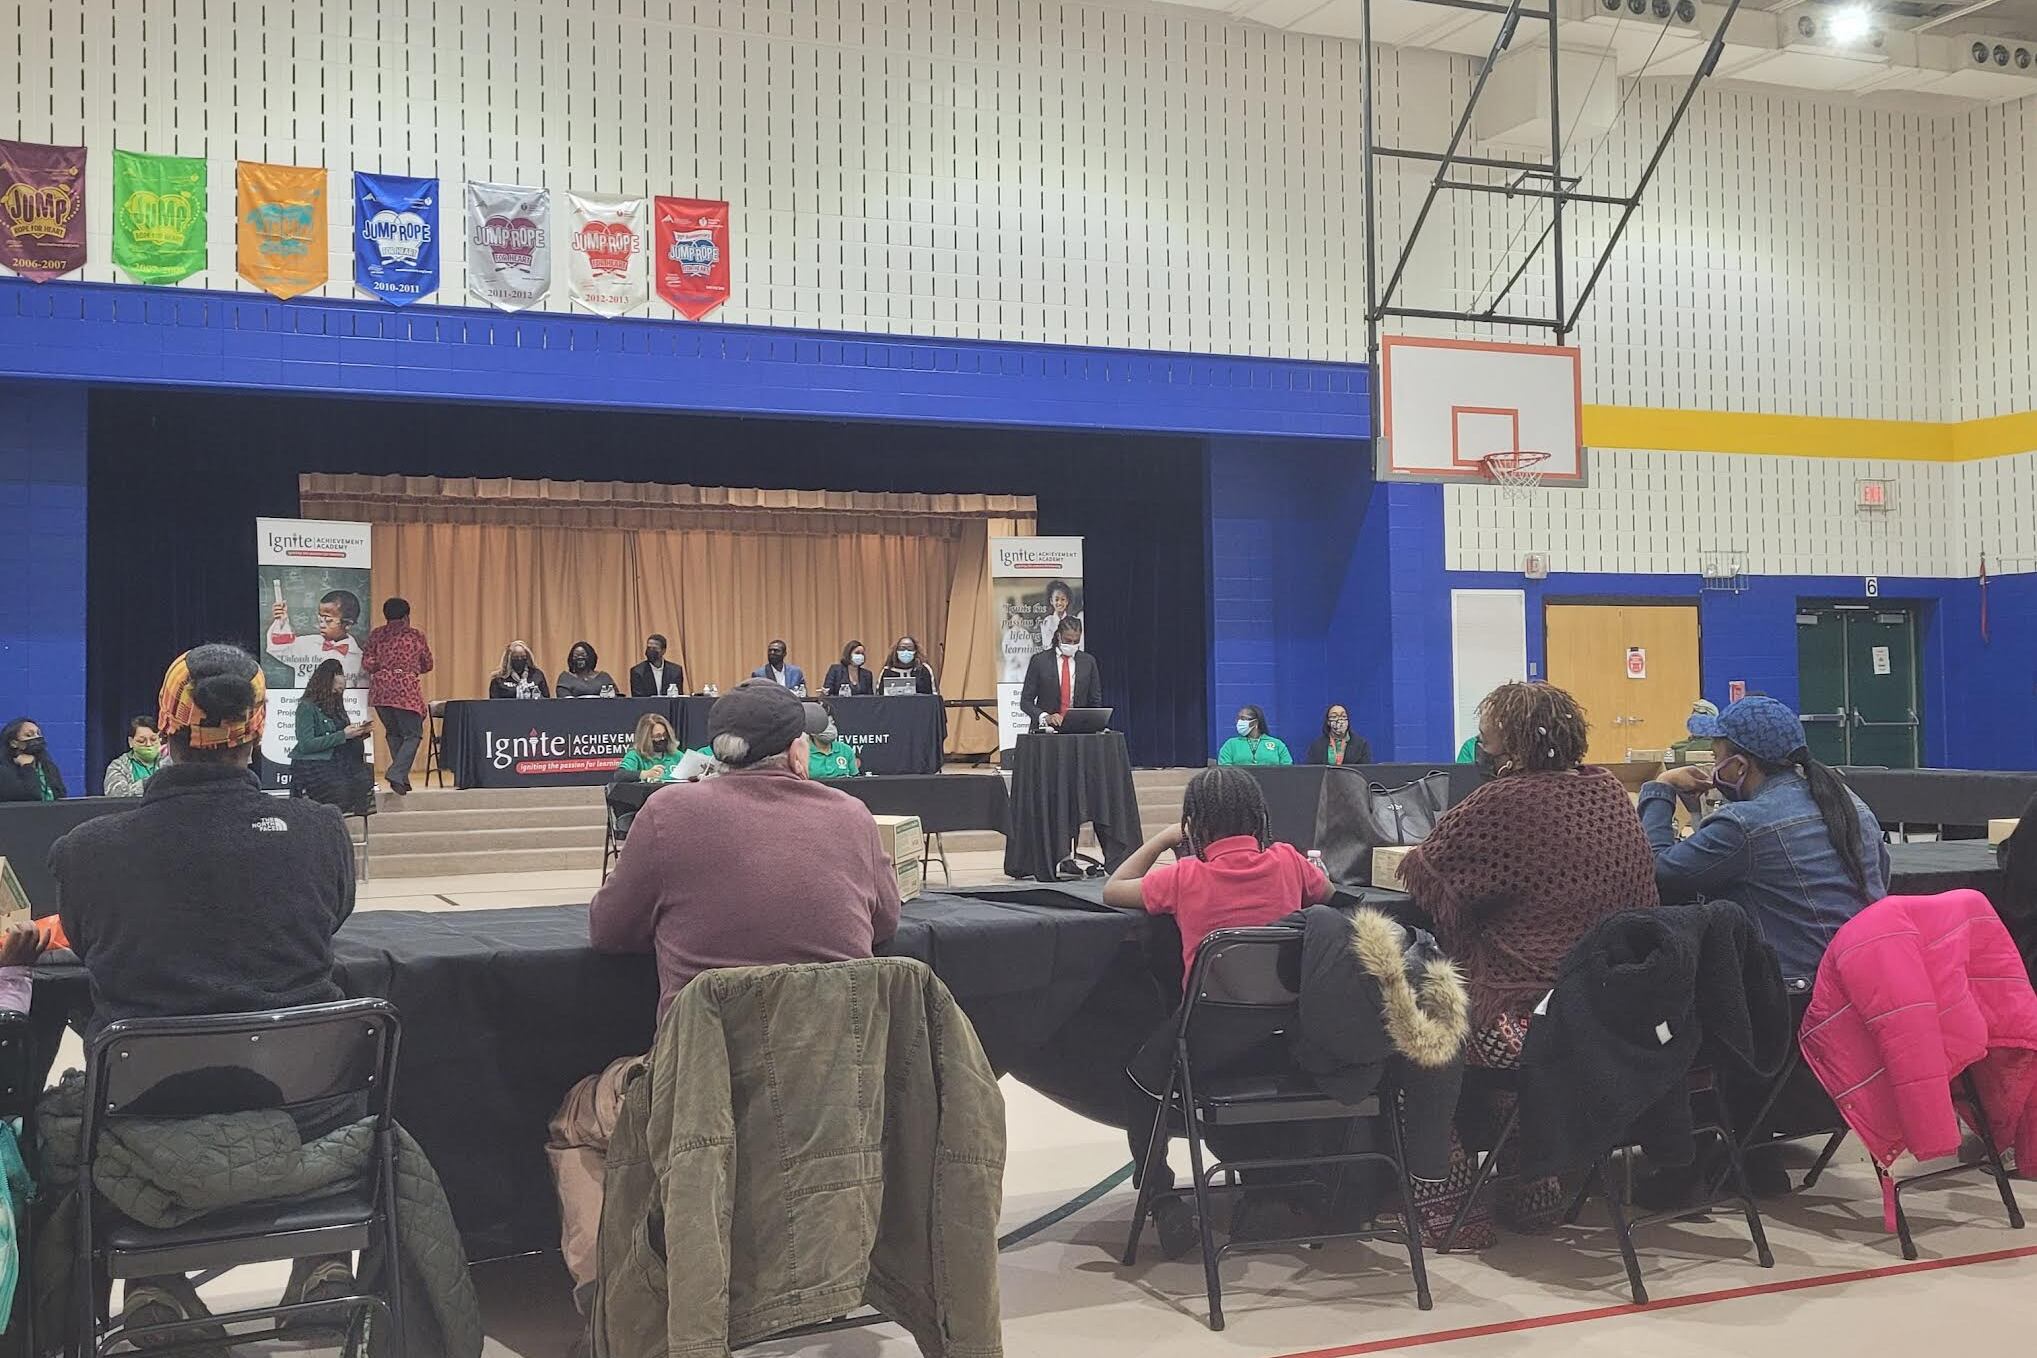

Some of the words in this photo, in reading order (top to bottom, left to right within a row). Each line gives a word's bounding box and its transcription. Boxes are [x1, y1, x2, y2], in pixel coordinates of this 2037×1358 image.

[10, 189, 67, 225] JUMP
[364, 221, 397, 240] JUMP
[400, 223, 430, 241] ROPE
[474, 226, 510, 248] JUMP
[511, 227, 545, 249] ROPE
[572, 232, 606, 253] JUMP
[608, 233, 640, 253] ROPE
[669, 244, 695, 260] JUMP
[695, 245, 719, 263] ROPE
[12, 258, 67, 269] 2006-2007
[374, 282, 420, 293] 2010-2011
[488, 289, 533, 299] 2011-2012
[585, 294, 630, 304] 2012-2013
[269, 532, 312, 552] Ignite
[316, 537, 364, 545] ACHIEVEMENT
[1000, 549, 1036, 566] Ignite
[1868, 579, 1876, 595] 6
[1010, 631, 1042, 643] lifelong
[838, 734, 889, 744] EVEMENT
[485, 730, 565, 769] Ignite
[573, 733, 635, 744] ACHIEVEM
[573, 744, 630, 755] ACADEMY
[520, 762, 547, 773] igniting
[548, 762, 559, 770] the
[559, 762, 585, 771] passion
[585, 760, 596, 770] for
[596, 759, 621, 769] learnin
